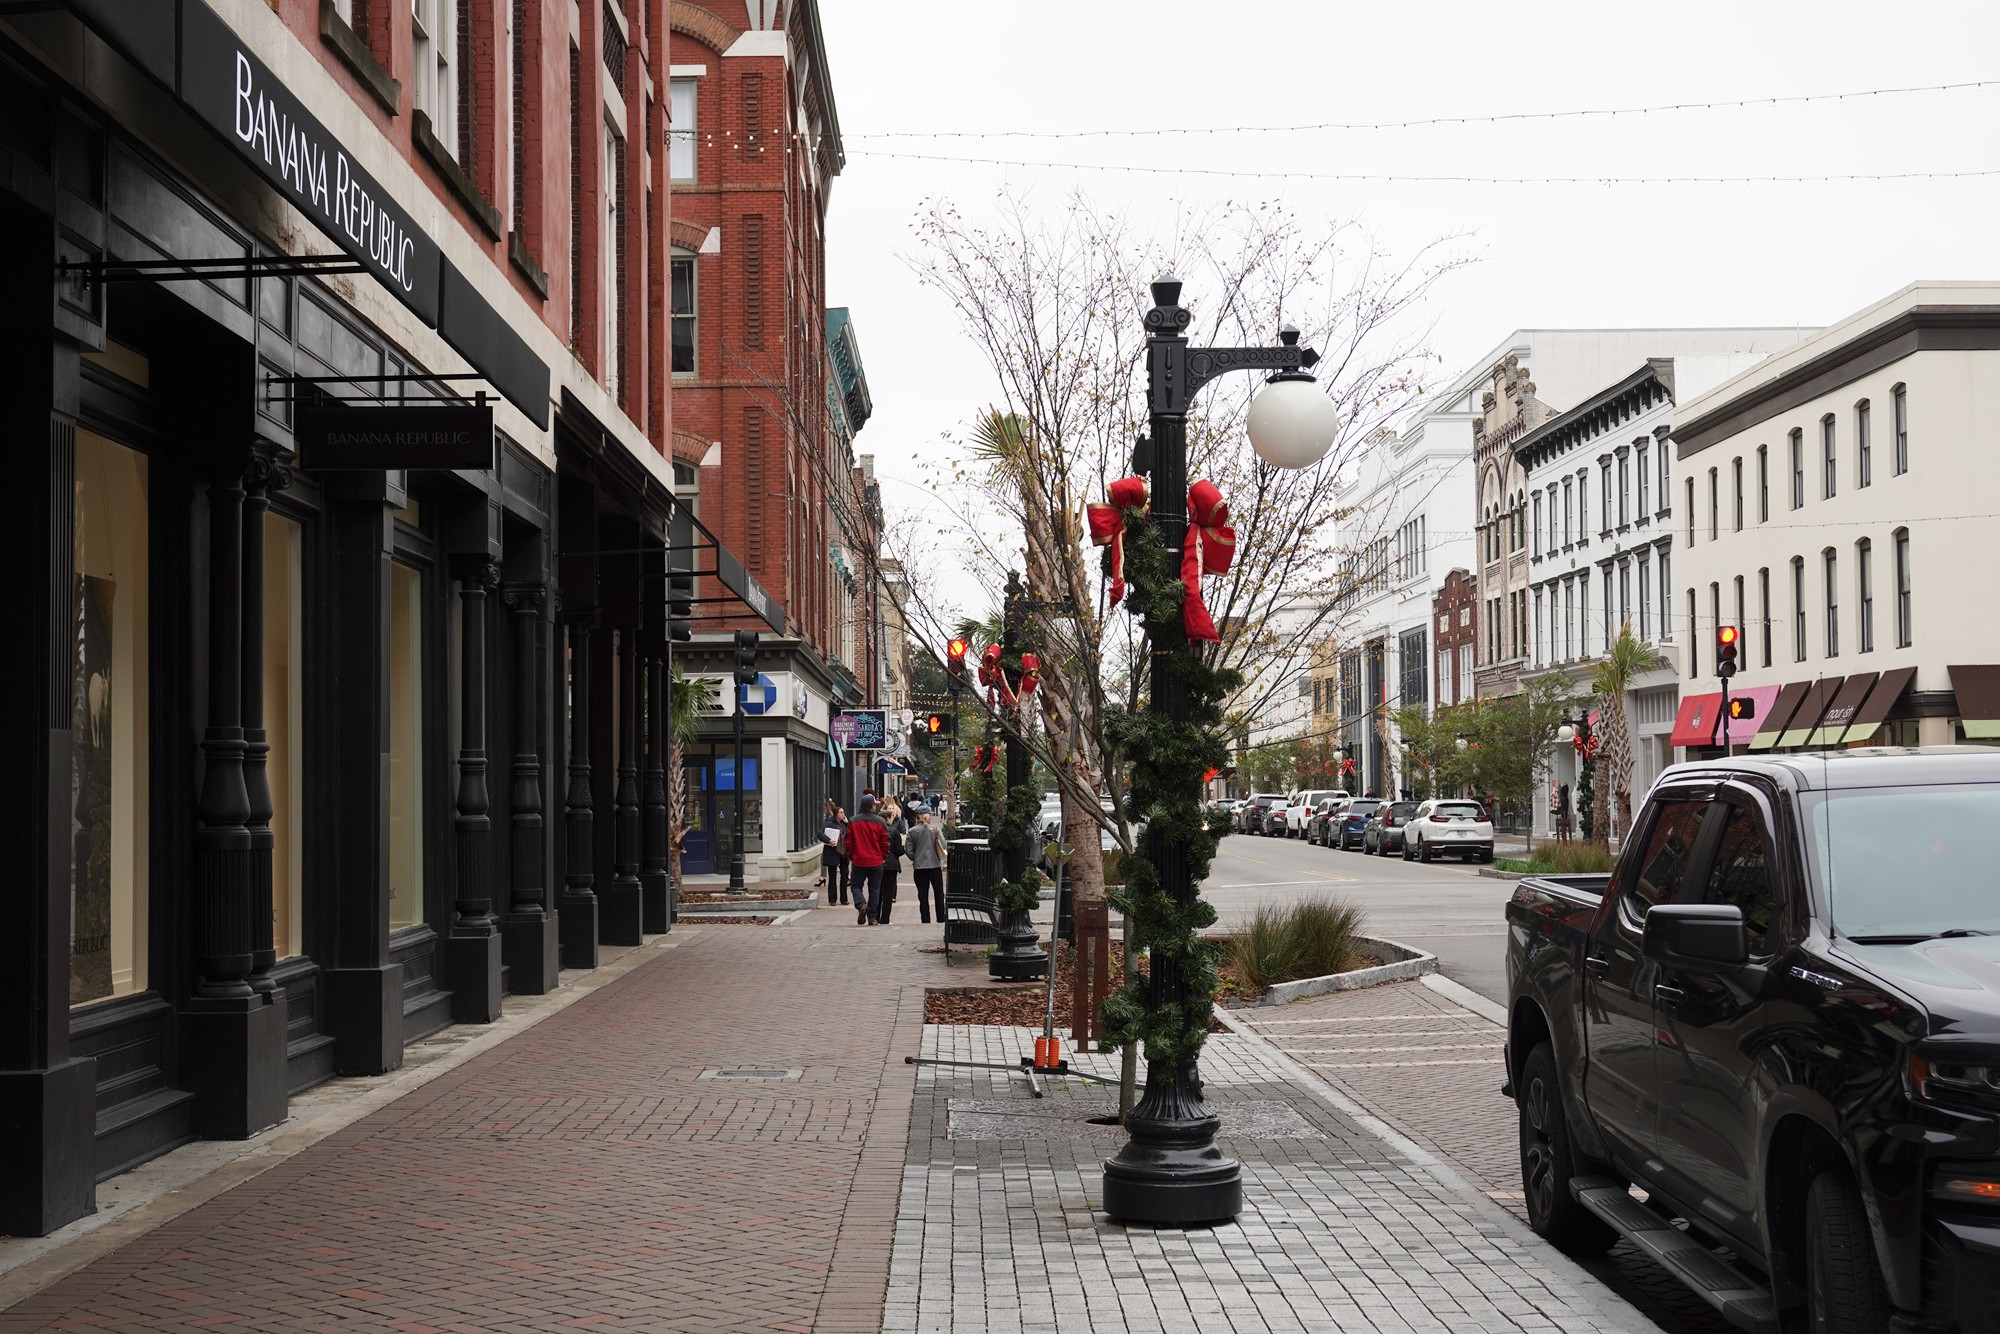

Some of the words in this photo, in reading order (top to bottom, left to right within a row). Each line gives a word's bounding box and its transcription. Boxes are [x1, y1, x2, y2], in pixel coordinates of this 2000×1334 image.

[234, 49, 330, 215] BANANA
[334, 150, 415, 293] REPUBLIC
[327, 432, 392, 446] BANANA
[395, 431, 471, 446] REPUBLIC
[73, 935, 109, 955] REPUBLIC
